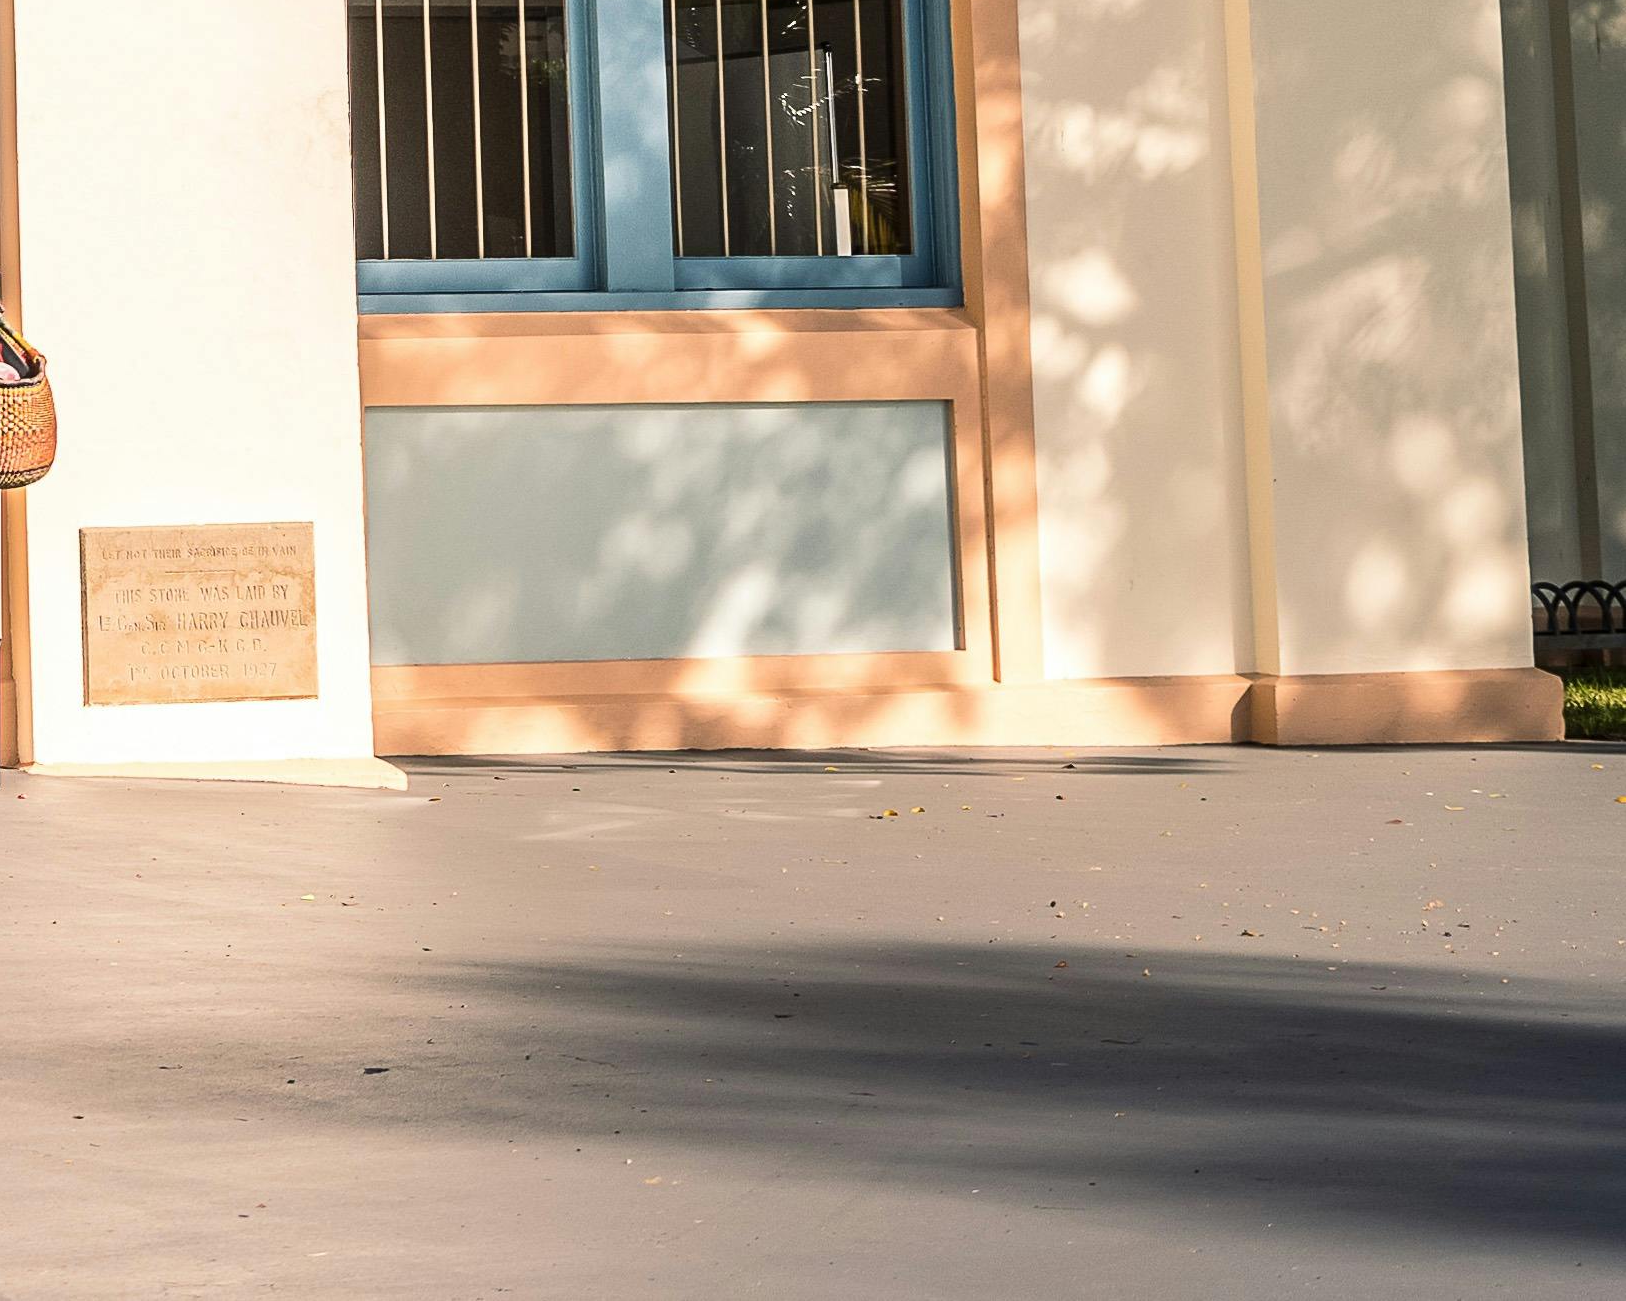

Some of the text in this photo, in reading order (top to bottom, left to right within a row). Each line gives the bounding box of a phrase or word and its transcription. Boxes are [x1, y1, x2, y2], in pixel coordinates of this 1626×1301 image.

[153, 548, 182, 560] THEIR
[187, 546, 238, 560] SACRIFICE
[271, 545, 297, 557] VAIN
[114, 583, 290, 605] THIS STONE WAS LAID BY
[176, 611, 230, 632] HARRY
[239, 608, 309, 630] CHAUVEL
[160, 663, 231, 681] OCTOBER
[243, 662, 278, 679] 1927
